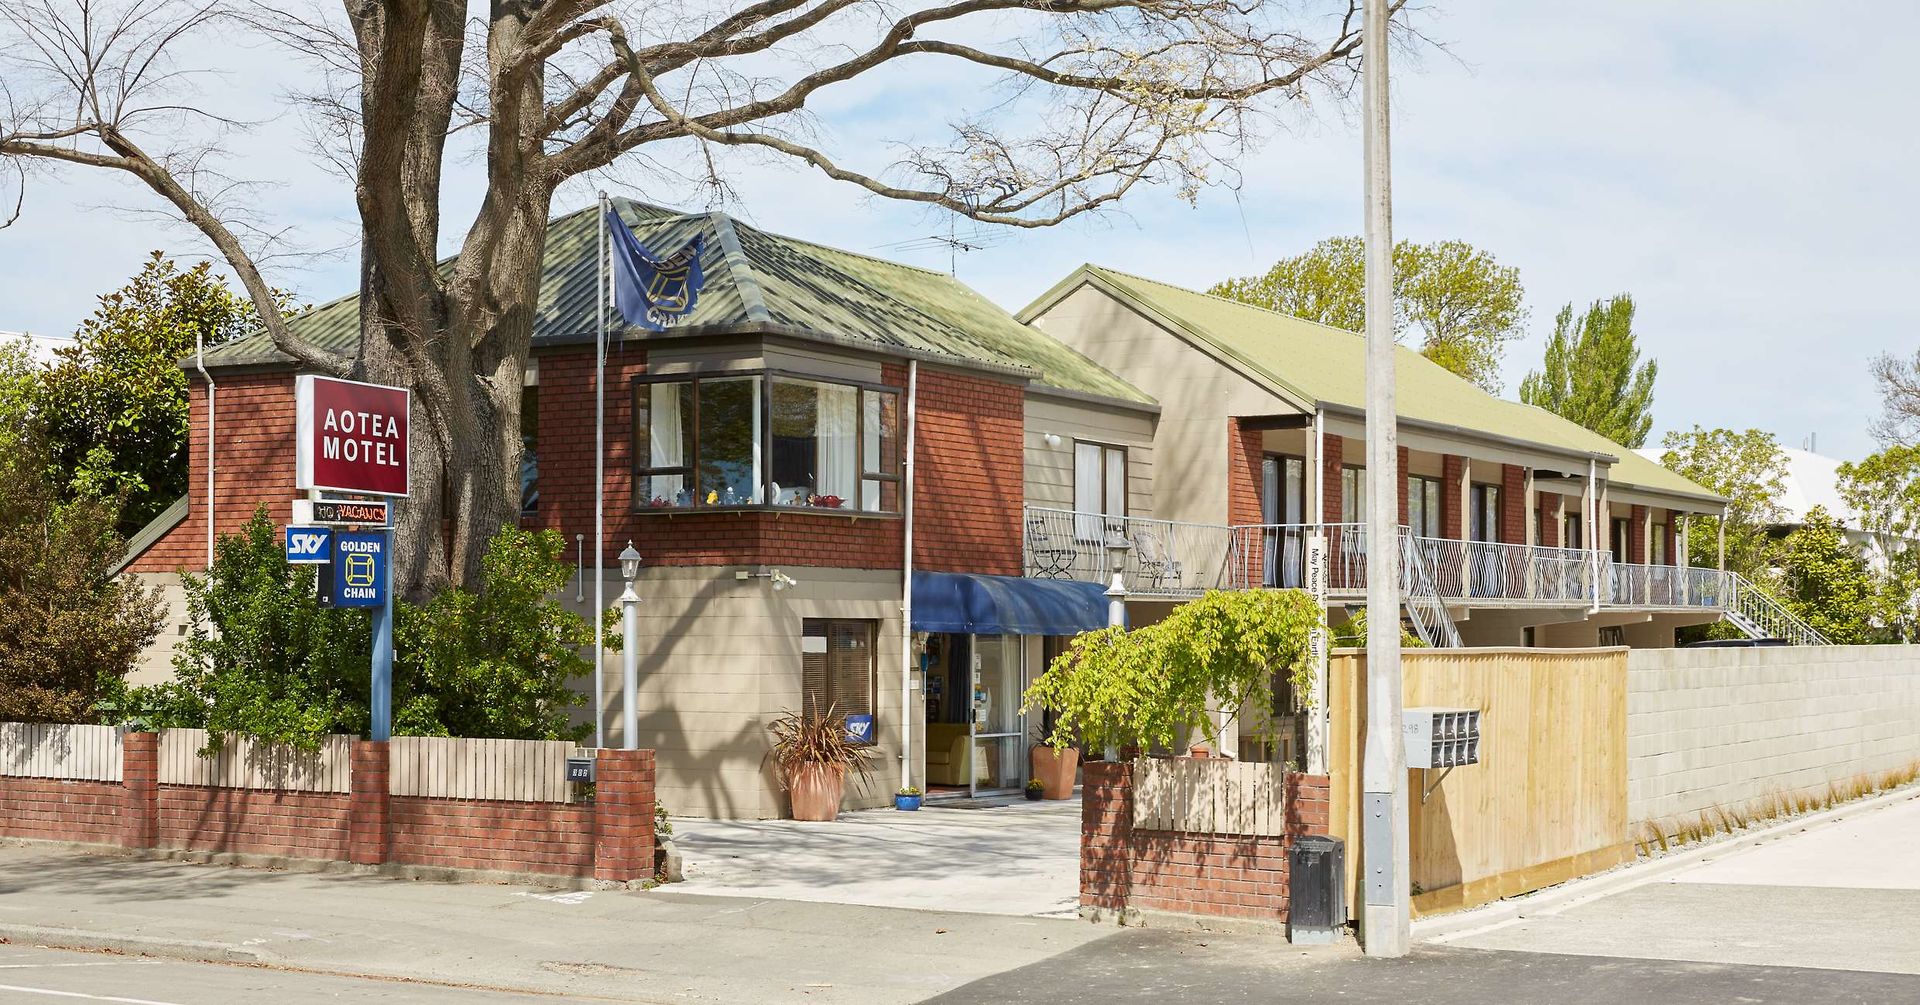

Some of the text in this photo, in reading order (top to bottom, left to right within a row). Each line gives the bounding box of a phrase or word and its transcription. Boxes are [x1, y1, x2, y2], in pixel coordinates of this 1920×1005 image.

[323, 408, 400, 439] AOTEA
[323, 436, 400, 466] MOTEL
[338, 504, 386, 521] VACANCY
[288, 533, 329, 554] SKY
[340, 540, 381, 553] GOLDEN
[1310, 548, 1319, 566] May
[1311, 567, 1319, 593] Peace
[343, 587, 376, 599] CHAIN
